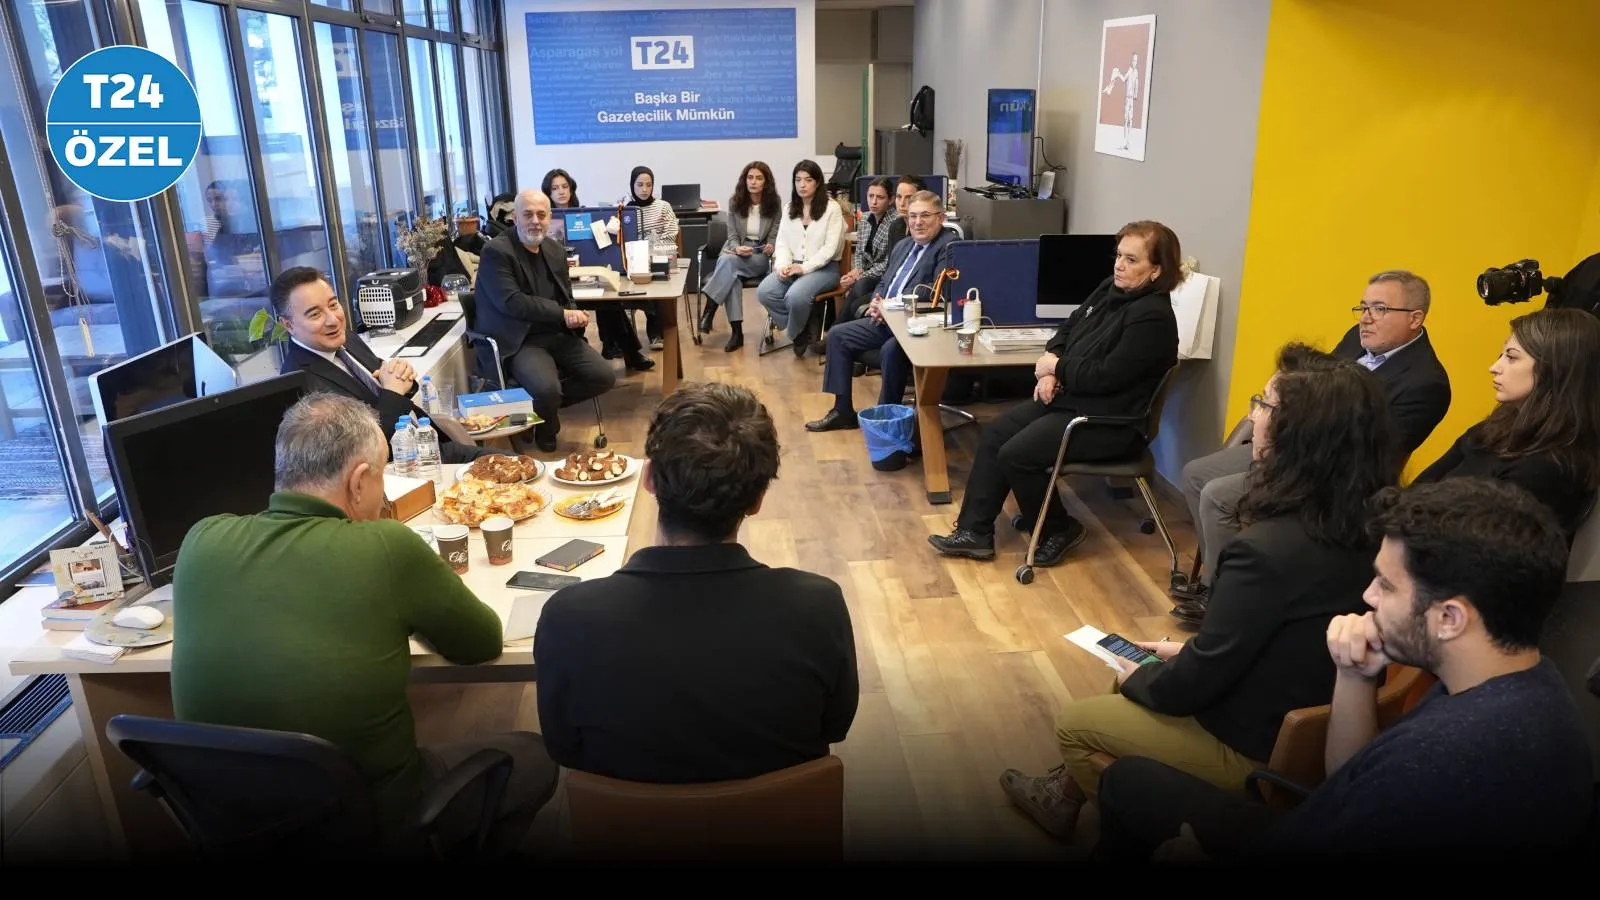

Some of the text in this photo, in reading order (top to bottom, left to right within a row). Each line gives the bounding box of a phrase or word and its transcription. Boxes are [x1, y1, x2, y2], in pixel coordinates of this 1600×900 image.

[530, 46, 600, 60] Asparagas
[635, 40, 689, 65] T24
[634, 91, 677, 106] Başka
[681, 91, 701, 103] Bir
[597, 109, 673, 123] Gazetecilik
[676, 108, 735, 121] Mümkün
